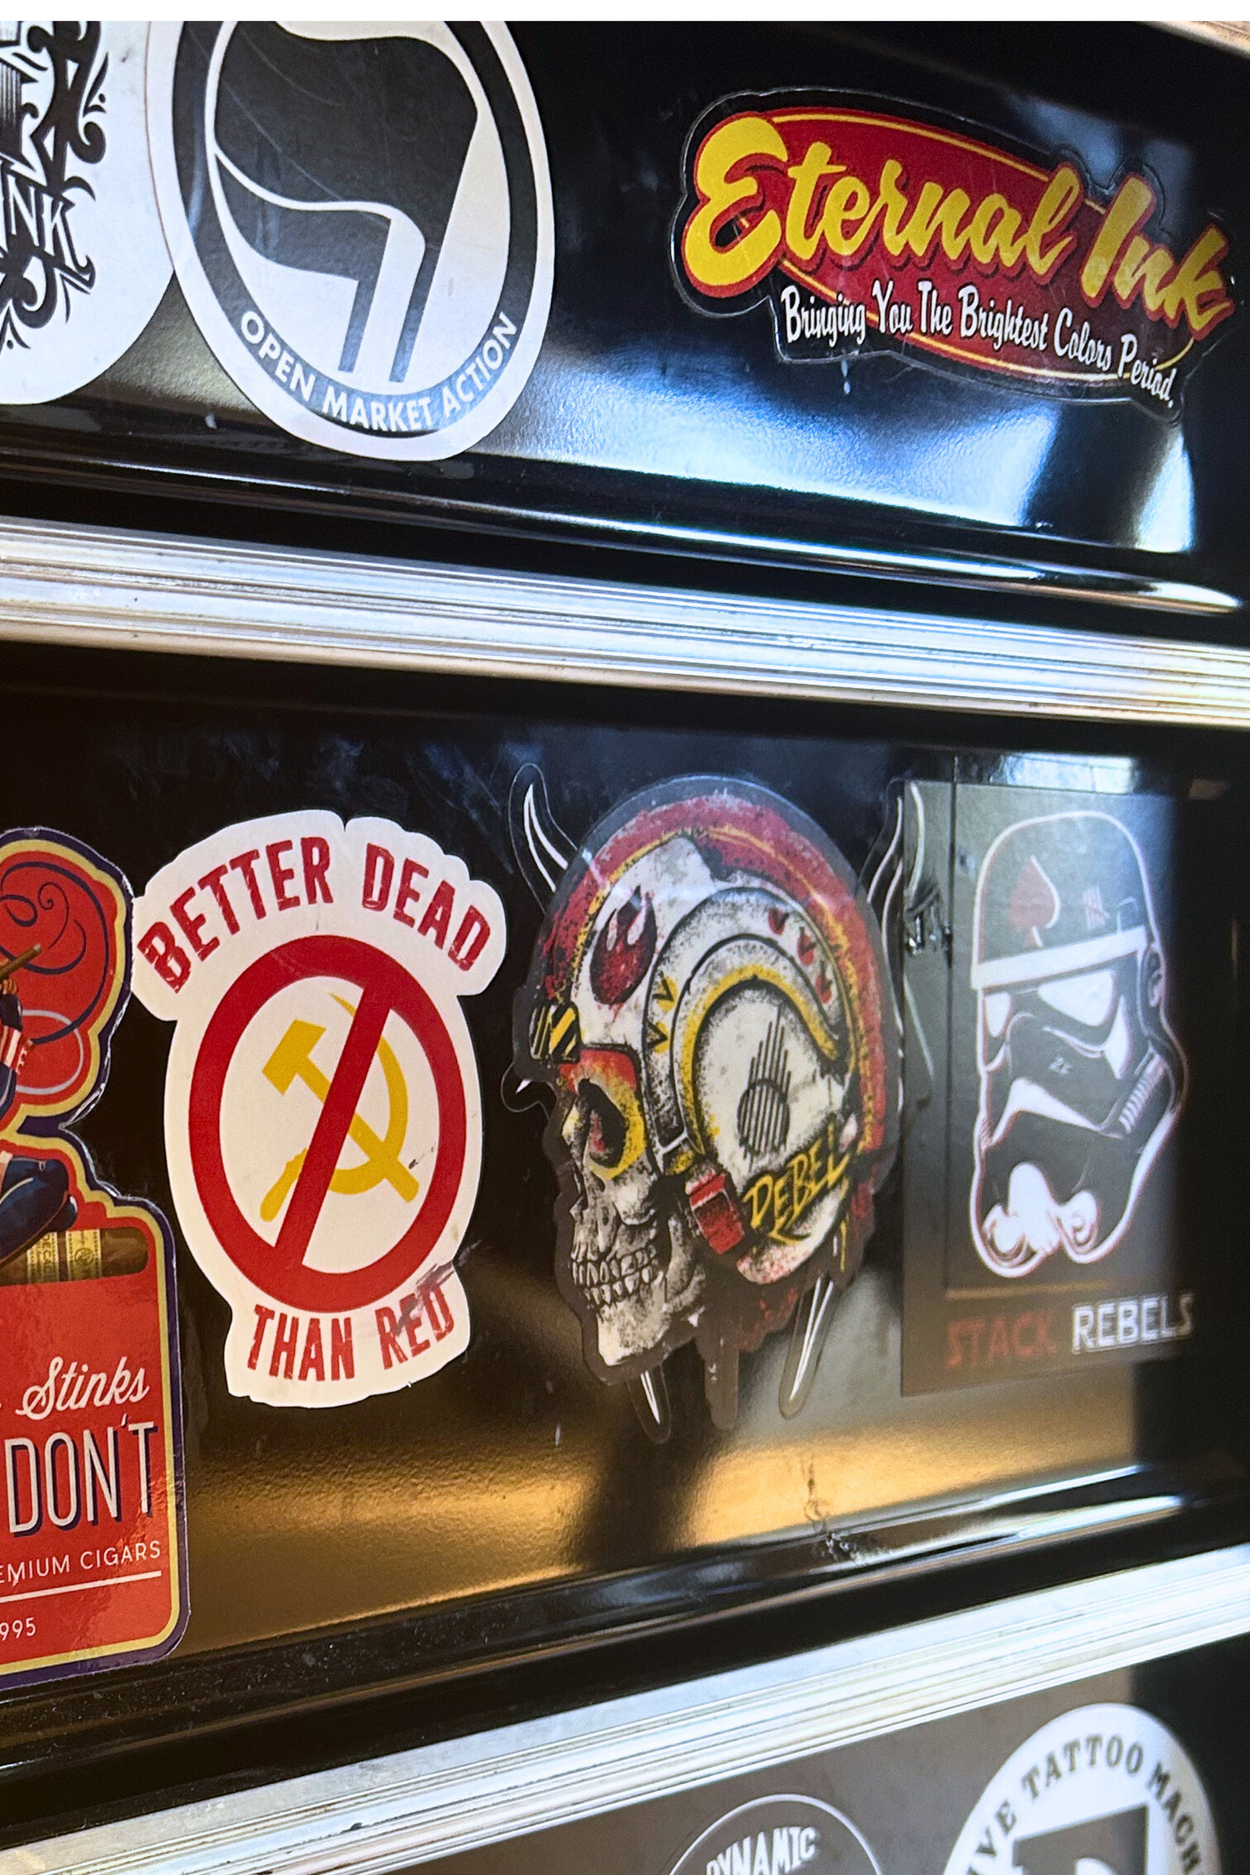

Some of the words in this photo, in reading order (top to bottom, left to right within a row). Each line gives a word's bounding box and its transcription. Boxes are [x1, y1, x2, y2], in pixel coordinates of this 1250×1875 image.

[684, 116, 1077, 286] Eternal
[1079, 178, 1231, 331] Ink
[241, 311, 316, 402] OPEN
[321, 385, 433, 432] MARKET
[441, 311, 518, 419] ACTION
[781, 285, 866, 348] Bringing
[872, 280, 914, 334] You
[917, 280, 953, 335] The
[958, 284, 1049, 351] Brightest
[1054, 307, 1112, 371] Colors
[1117, 333, 1178, 409] Period.
[137, 835, 334, 993] BETTER
[361, 842, 492, 973] DEAD
[246, 1304, 356, 1382] THAN
[375, 1286, 454, 1370] RED
[1070, 1292, 1194, 1354] REBELS
[15, 1355, 150, 1420] Stinks
[4, 1412, 156, 1536] DON'T
[80, 1540, 162, 1570] CIGARS
[1022, 1734, 1144, 1800] TATTOO
[1147, 1761, 1206, 1875] MACH
